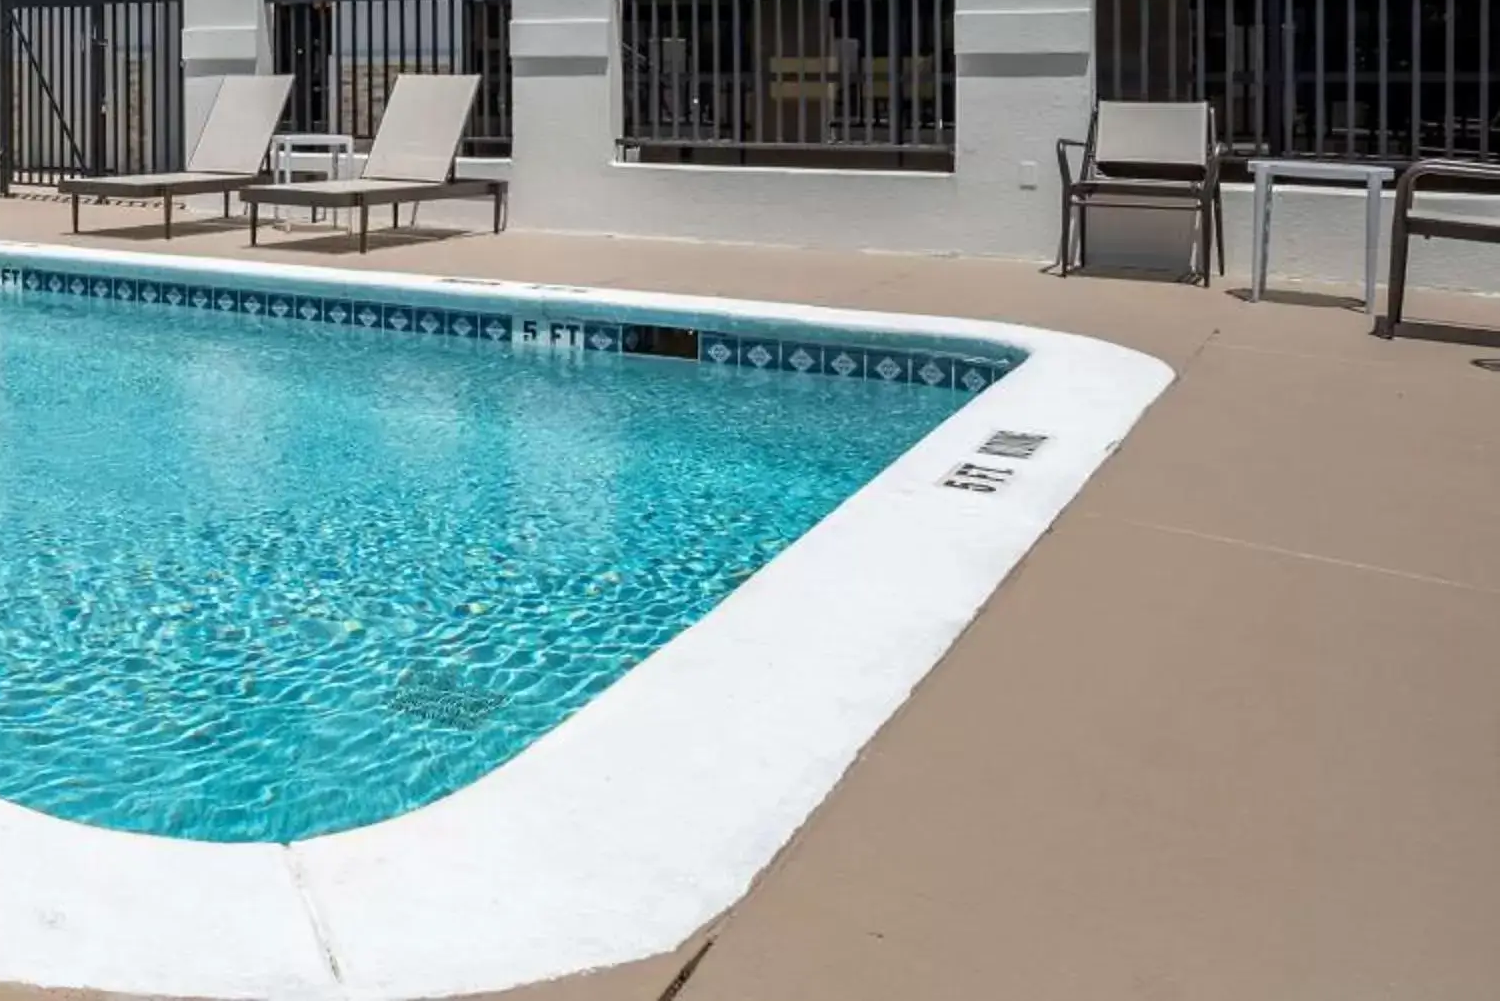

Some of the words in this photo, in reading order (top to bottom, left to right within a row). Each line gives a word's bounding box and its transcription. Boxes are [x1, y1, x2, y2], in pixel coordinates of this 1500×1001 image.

[2, 269, 20, 285] FT
[523, 320, 537, 341] 5
[551, 324, 580, 346] FT
